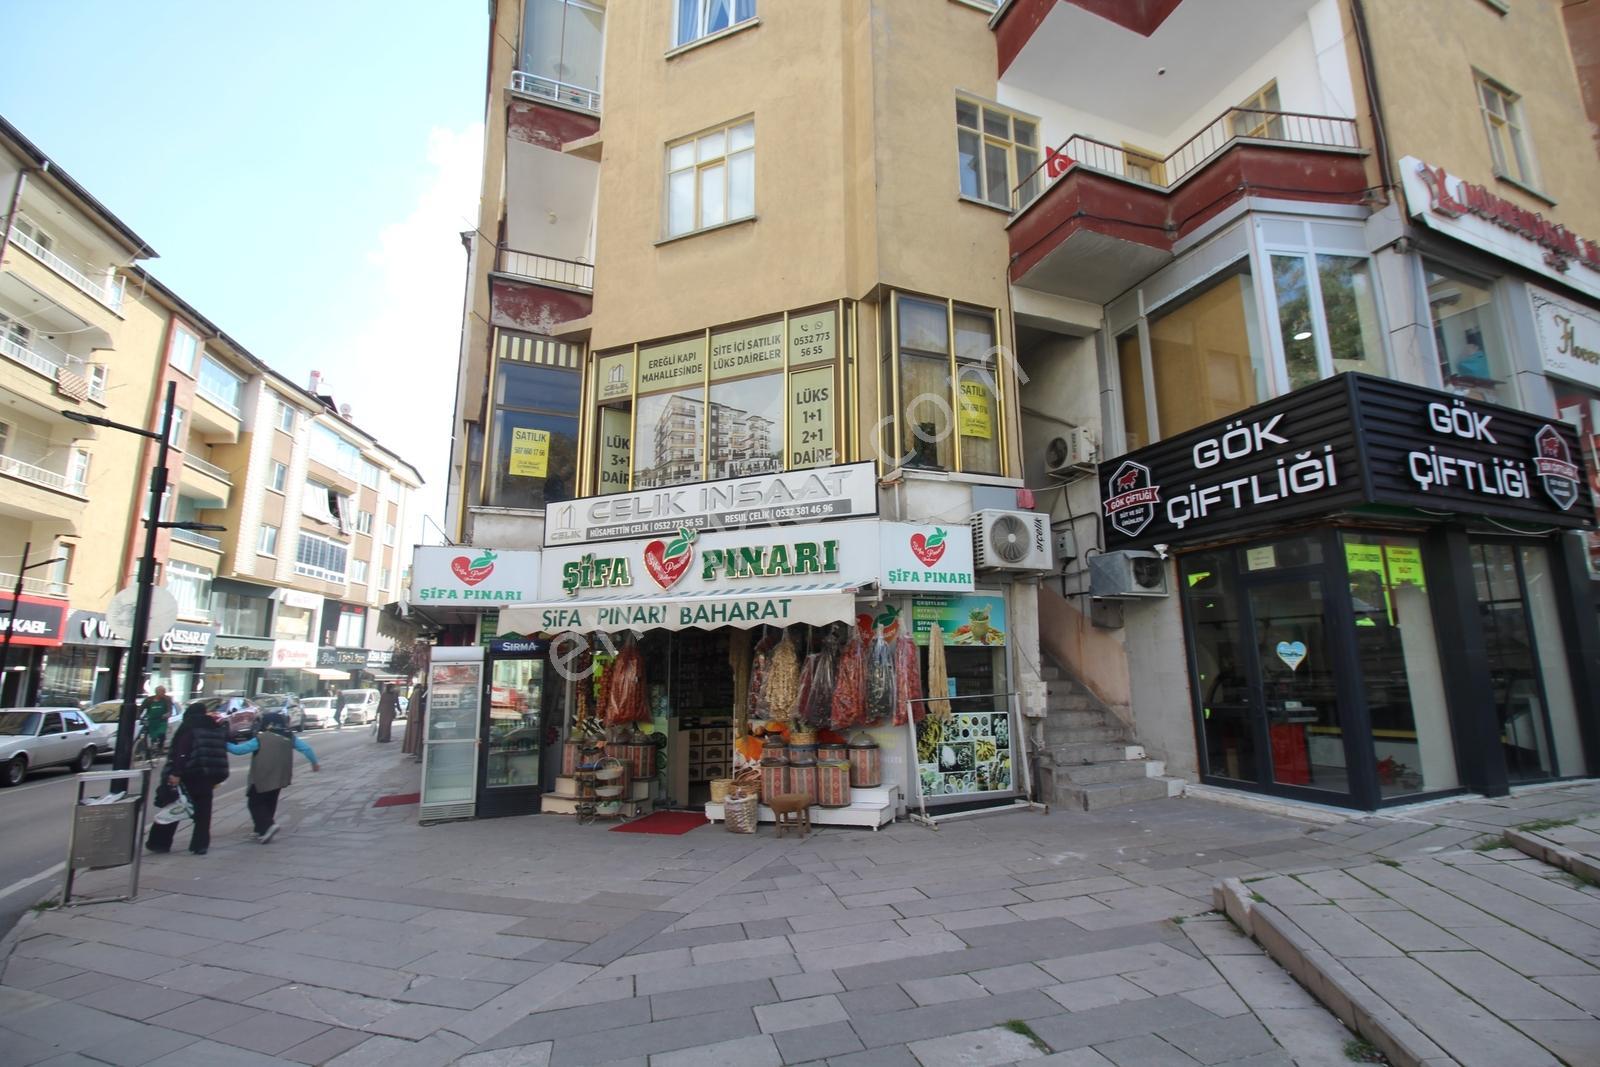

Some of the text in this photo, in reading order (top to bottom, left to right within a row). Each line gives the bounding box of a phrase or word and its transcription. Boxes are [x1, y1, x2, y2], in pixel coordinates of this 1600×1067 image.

[713, 334, 781, 356] SİTE İÇİ SATILIK
[794, 331, 830, 346] 0532 773
[648, 351, 696, 369] EREĞLİ KAPI
[713, 348, 781, 370] LÜKS DAİRELER
[801, 345, 823, 357] 56 55
[641, 363, 703, 383] MAHALLESİNDE
[796, 387, 829, 405] LÜKS
[802, 409, 822, 423] 1+1
[1428, 399, 1498, 445] GÖK
[515, 430, 546, 443] SATILIK
[606, 434, 631, 450] LÜK
[801, 428, 824, 444] 2+1
[1193, 413, 1290, 470] GÖK
[793, 446, 833, 466] DAİRE
[602, 470, 631, 484] DAİR
[1408, 445, 1531, 499] ÇİFTLİĞİ
[1166, 444, 1339, 529] ÇİFTLİĞİ
[1110, 489, 1152, 510] GÖK ÇİFTLİĞİ
[724, 511, 748, 523] RESUL
[775, 507, 795, 518] 0532
[796, 505, 809, 516] 381
[811, 504, 822, 514] 46
[823, 503, 834, 513] 96
[590, 524, 629, 538] HÜSAMETTİN
[654, 521, 671, 531] 0532
[672, 519, 684, 529] 773
[685, 518, 694, 527] 56
[695, 516, 703, 526] 55
[562, 539, 840, 596] ŞİFA PINARI
[888, 568, 972, 584] ŞİFA PINARI
[420, 587, 522, 601] ŞİFA PINARI
[598, 605, 666, 626] PINARI
[680, 598, 792, 626] BAHARAT
